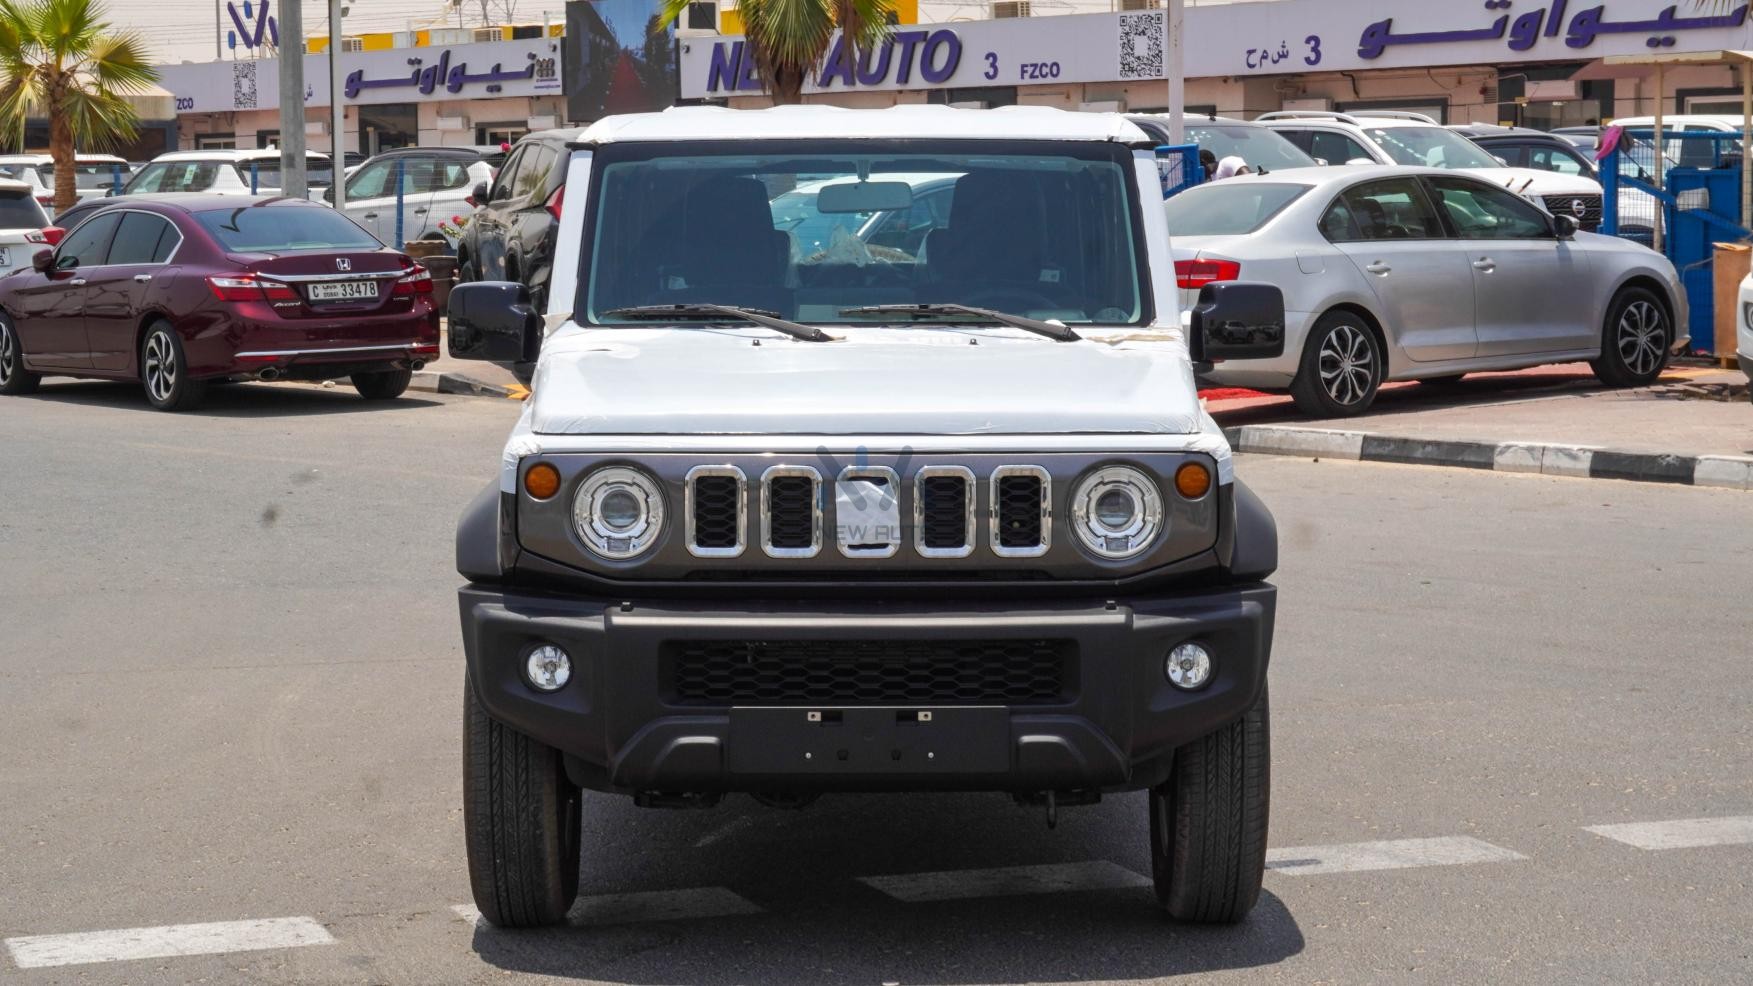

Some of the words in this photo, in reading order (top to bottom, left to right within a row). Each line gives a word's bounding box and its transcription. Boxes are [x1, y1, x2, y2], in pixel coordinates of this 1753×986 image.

[1304, 34, 1322, 66] 3
[707, 40, 778, 91] NE
[817, 29, 962, 87] AUTO
[984, 52, 999, 80] 3
[1020, 61, 1060, 80] FZCO
[176, 97, 194, 111] ZCO
[313, 285, 320, 298] C
[341, 282, 377, 297] 33478
